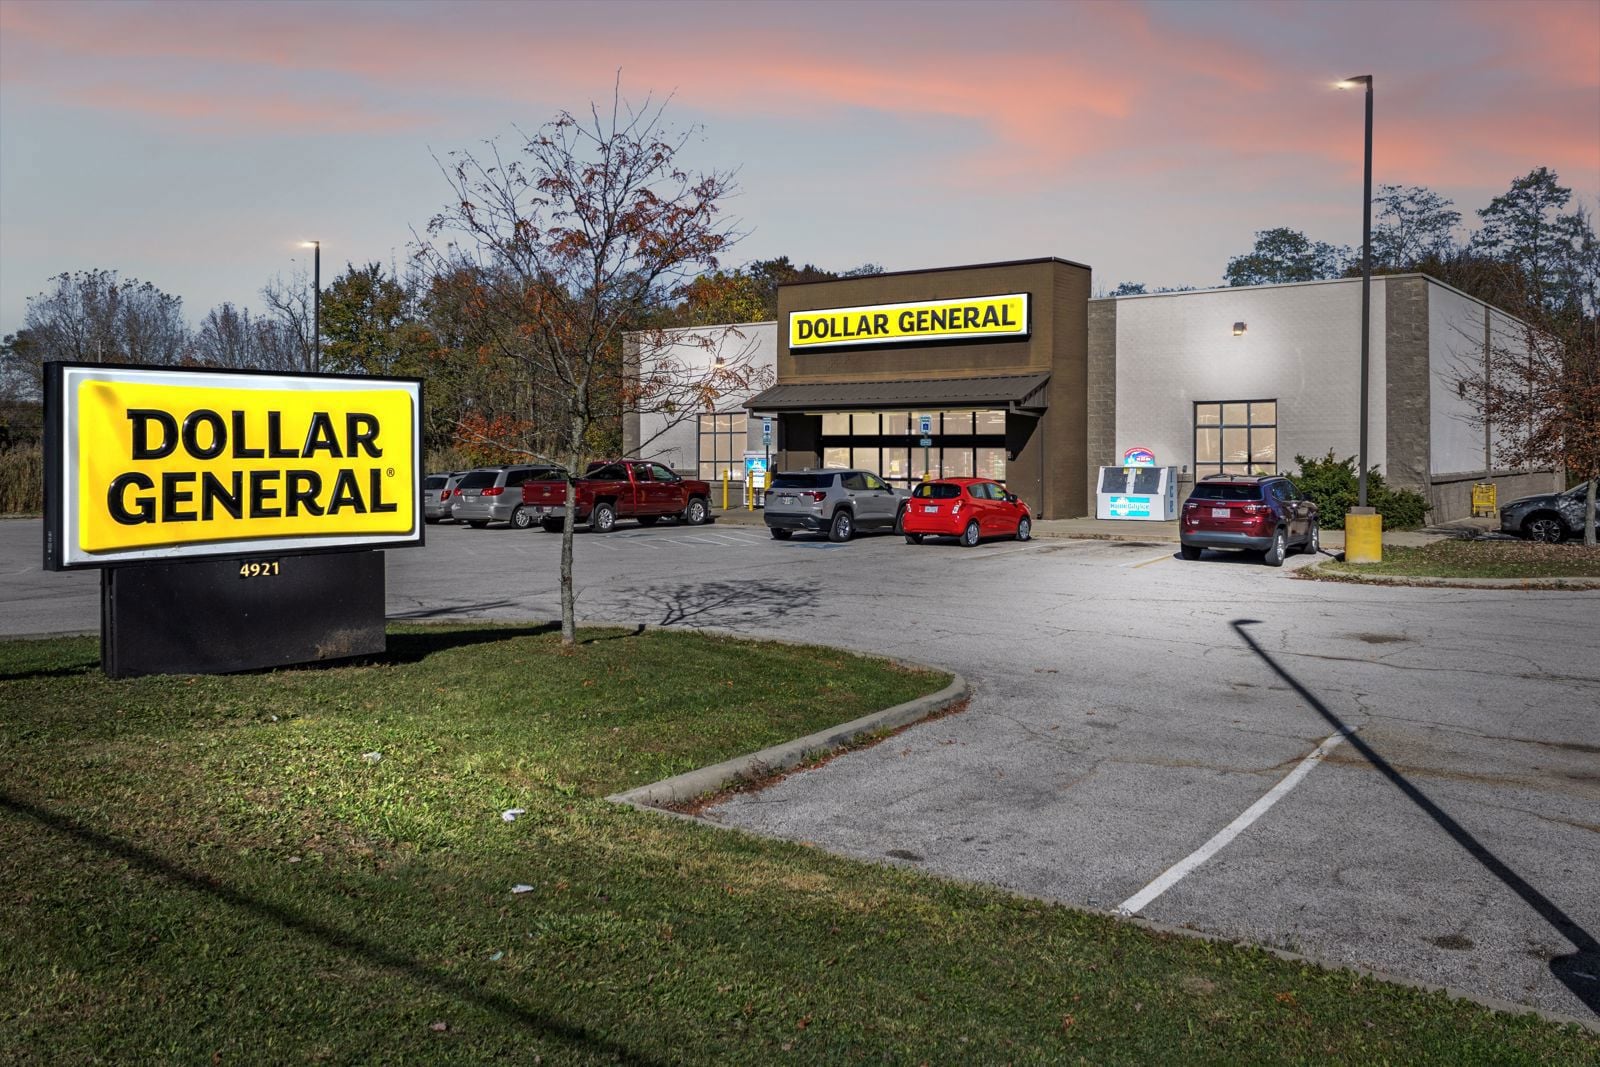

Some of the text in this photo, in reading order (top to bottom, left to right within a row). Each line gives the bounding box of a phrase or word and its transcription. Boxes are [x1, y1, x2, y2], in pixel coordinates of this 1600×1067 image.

[797, 313, 889, 340] DOLLAR
[126, 408, 383, 460] DOLLAR
[239, 561, 279, 577] 4921
